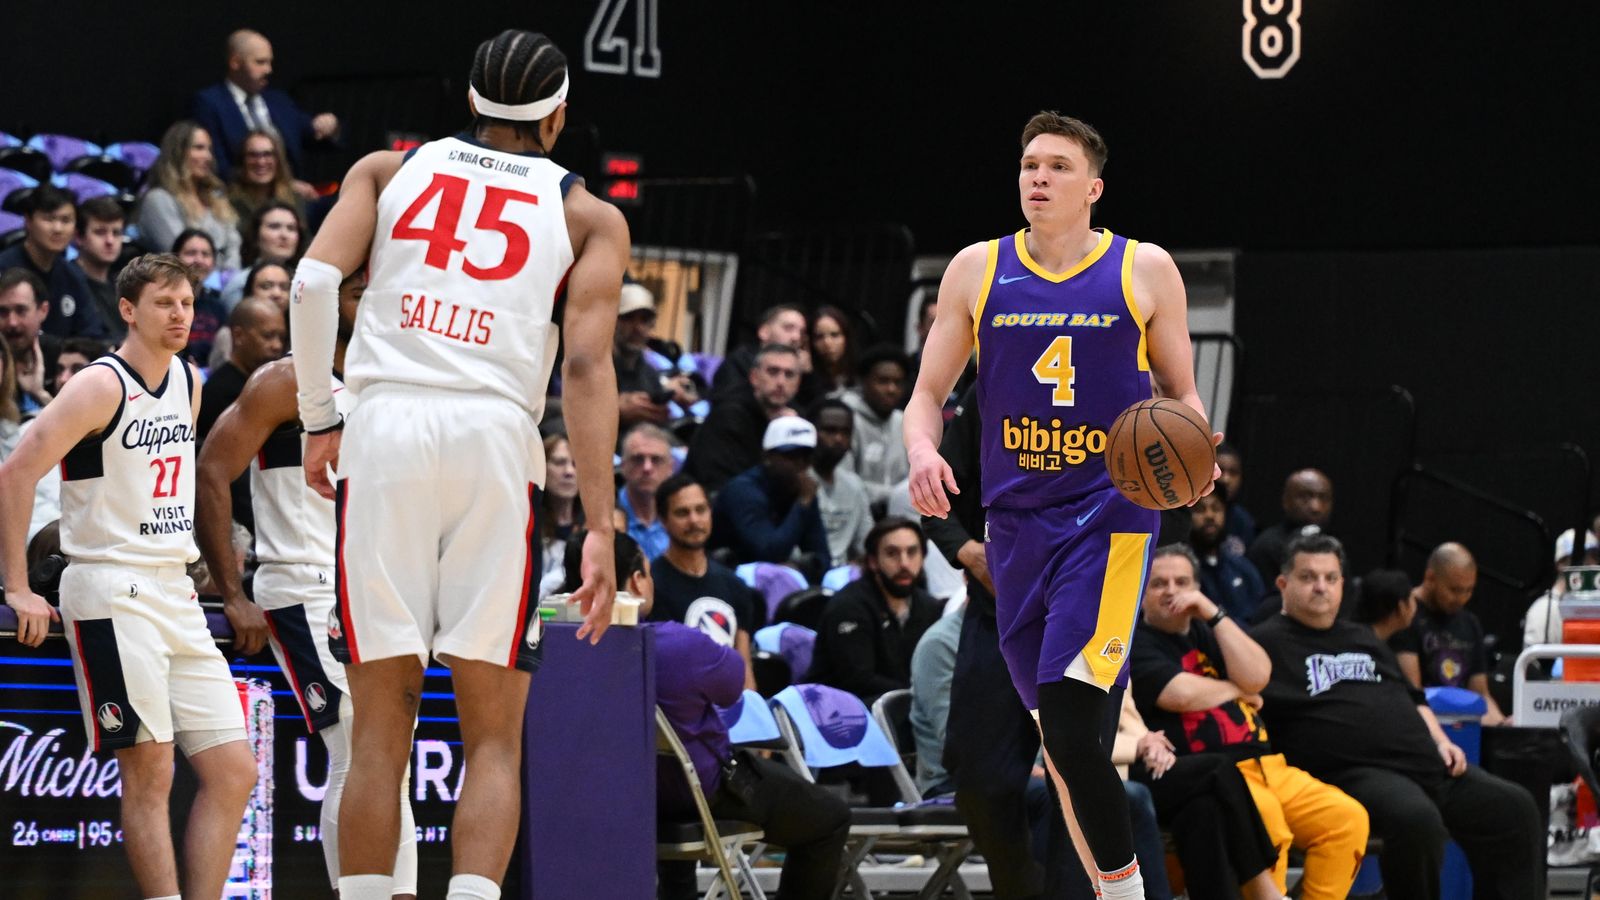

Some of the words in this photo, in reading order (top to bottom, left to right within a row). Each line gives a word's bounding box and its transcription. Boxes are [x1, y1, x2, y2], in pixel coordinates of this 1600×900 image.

[1242, 0, 1301, 79] 8
[457, 151, 479, 166] NBA
[495, 160, 531, 178] LEAGUE
[391, 172, 539, 281] 45
[400, 293, 495, 346] SALLIS
[992, 312, 1069, 328] SOUTH
[1068, 312, 1120, 328] BAY
[1031, 335, 1076, 407] 4
[1002, 416, 1108, 465] bibigo
[150, 455, 182, 498] 27
[1018, 452, 1062, 471] 비비고
[1144, 440, 1182, 506] Wilson
[139, 519, 193, 536] RWAND
[152, 505, 185, 520] VISIT
[1533, 697, 1600, 712] GATOR
[0, 721, 122, 798] Miche
[12, 821, 39, 846] 26
[88, 821, 112, 846] 95
[416, 826, 447, 842] GHT
